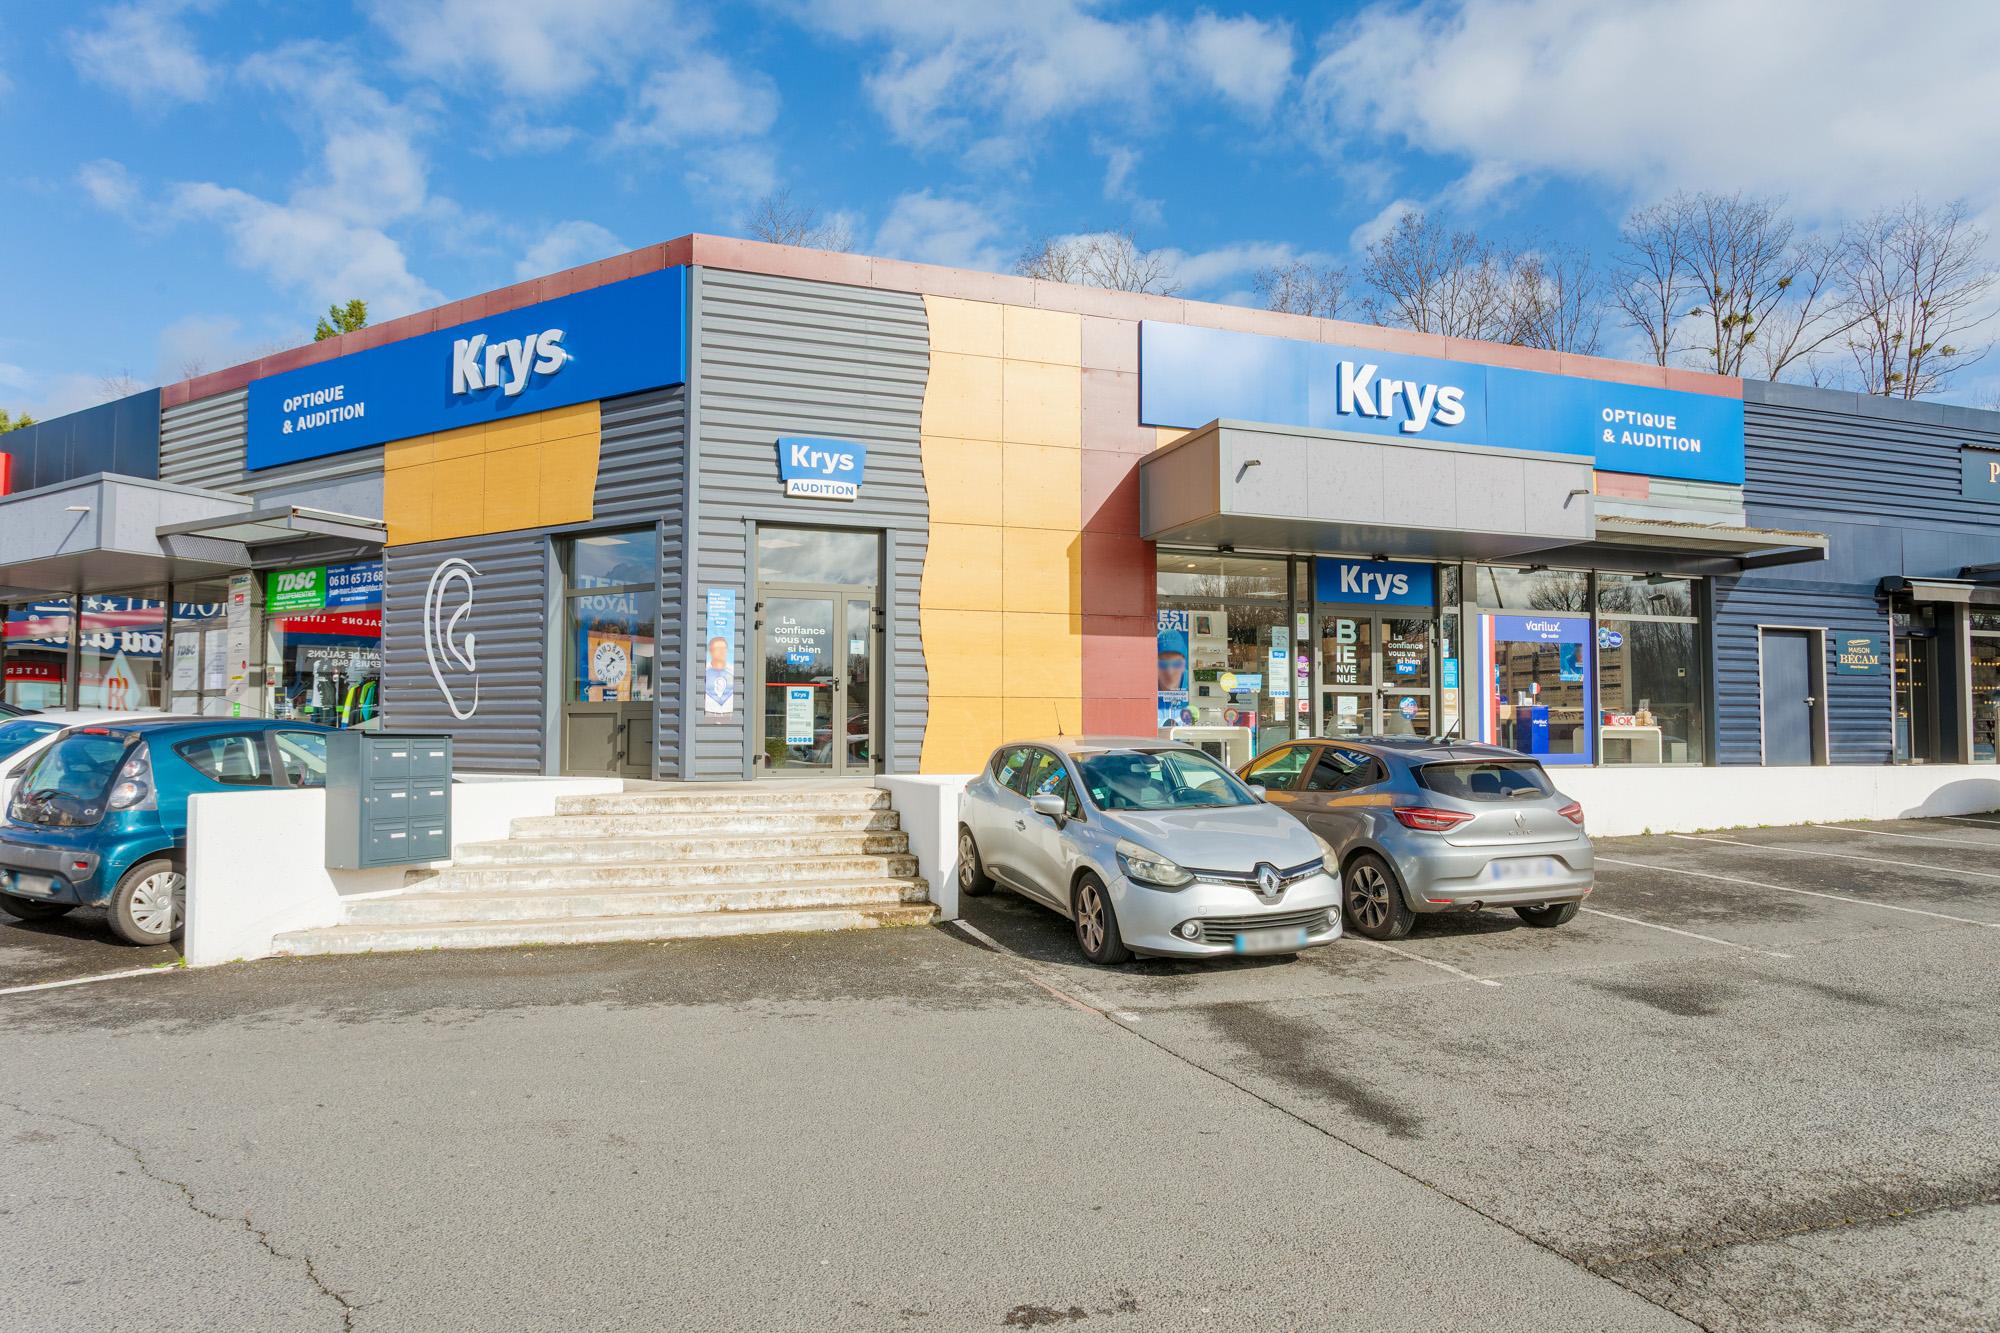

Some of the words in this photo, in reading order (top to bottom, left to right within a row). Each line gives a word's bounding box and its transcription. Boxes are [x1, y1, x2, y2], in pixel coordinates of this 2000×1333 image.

[453, 328, 567, 397] Krys
[283, 385, 344, 413] OPTIQUE
[1337, 361, 1466, 433] Krys
[282, 419, 293, 435] &
[296, 402, 364, 432] AUDITION
[1602, 407, 1677, 430] OPTIQUE
[1603, 429, 1615, 443] &
[1621, 430, 1701, 453] AUDITION
[791, 444, 855, 474] Krys
[791, 482, 854, 496] AUDITION
[277, 571, 317, 592] TDSC
[329, 576, 339, 586] 06
[340, 575, 349, 585] 81
[351, 574, 361, 584] 65
[363, 572, 371, 582] 73
[373, 571, 383, 581] 68
[1341, 564, 1409, 601] Krys
[580, 597, 638, 614] ROYAL
[783, 616, 796, 624] La
[775, 626, 826, 635] confiance
[1336, 619, 1357, 644] B
[1393, 633, 1403, 641] La
[775, 636, 800, 644] vous
[787, 644, 796, 652] si
[798, 645, 821, 654] bien
[790, 653, 810, 663] Krys
[1336, 665, 1357, 673] NVE
[1336, 674, 1357, 684] NUE
